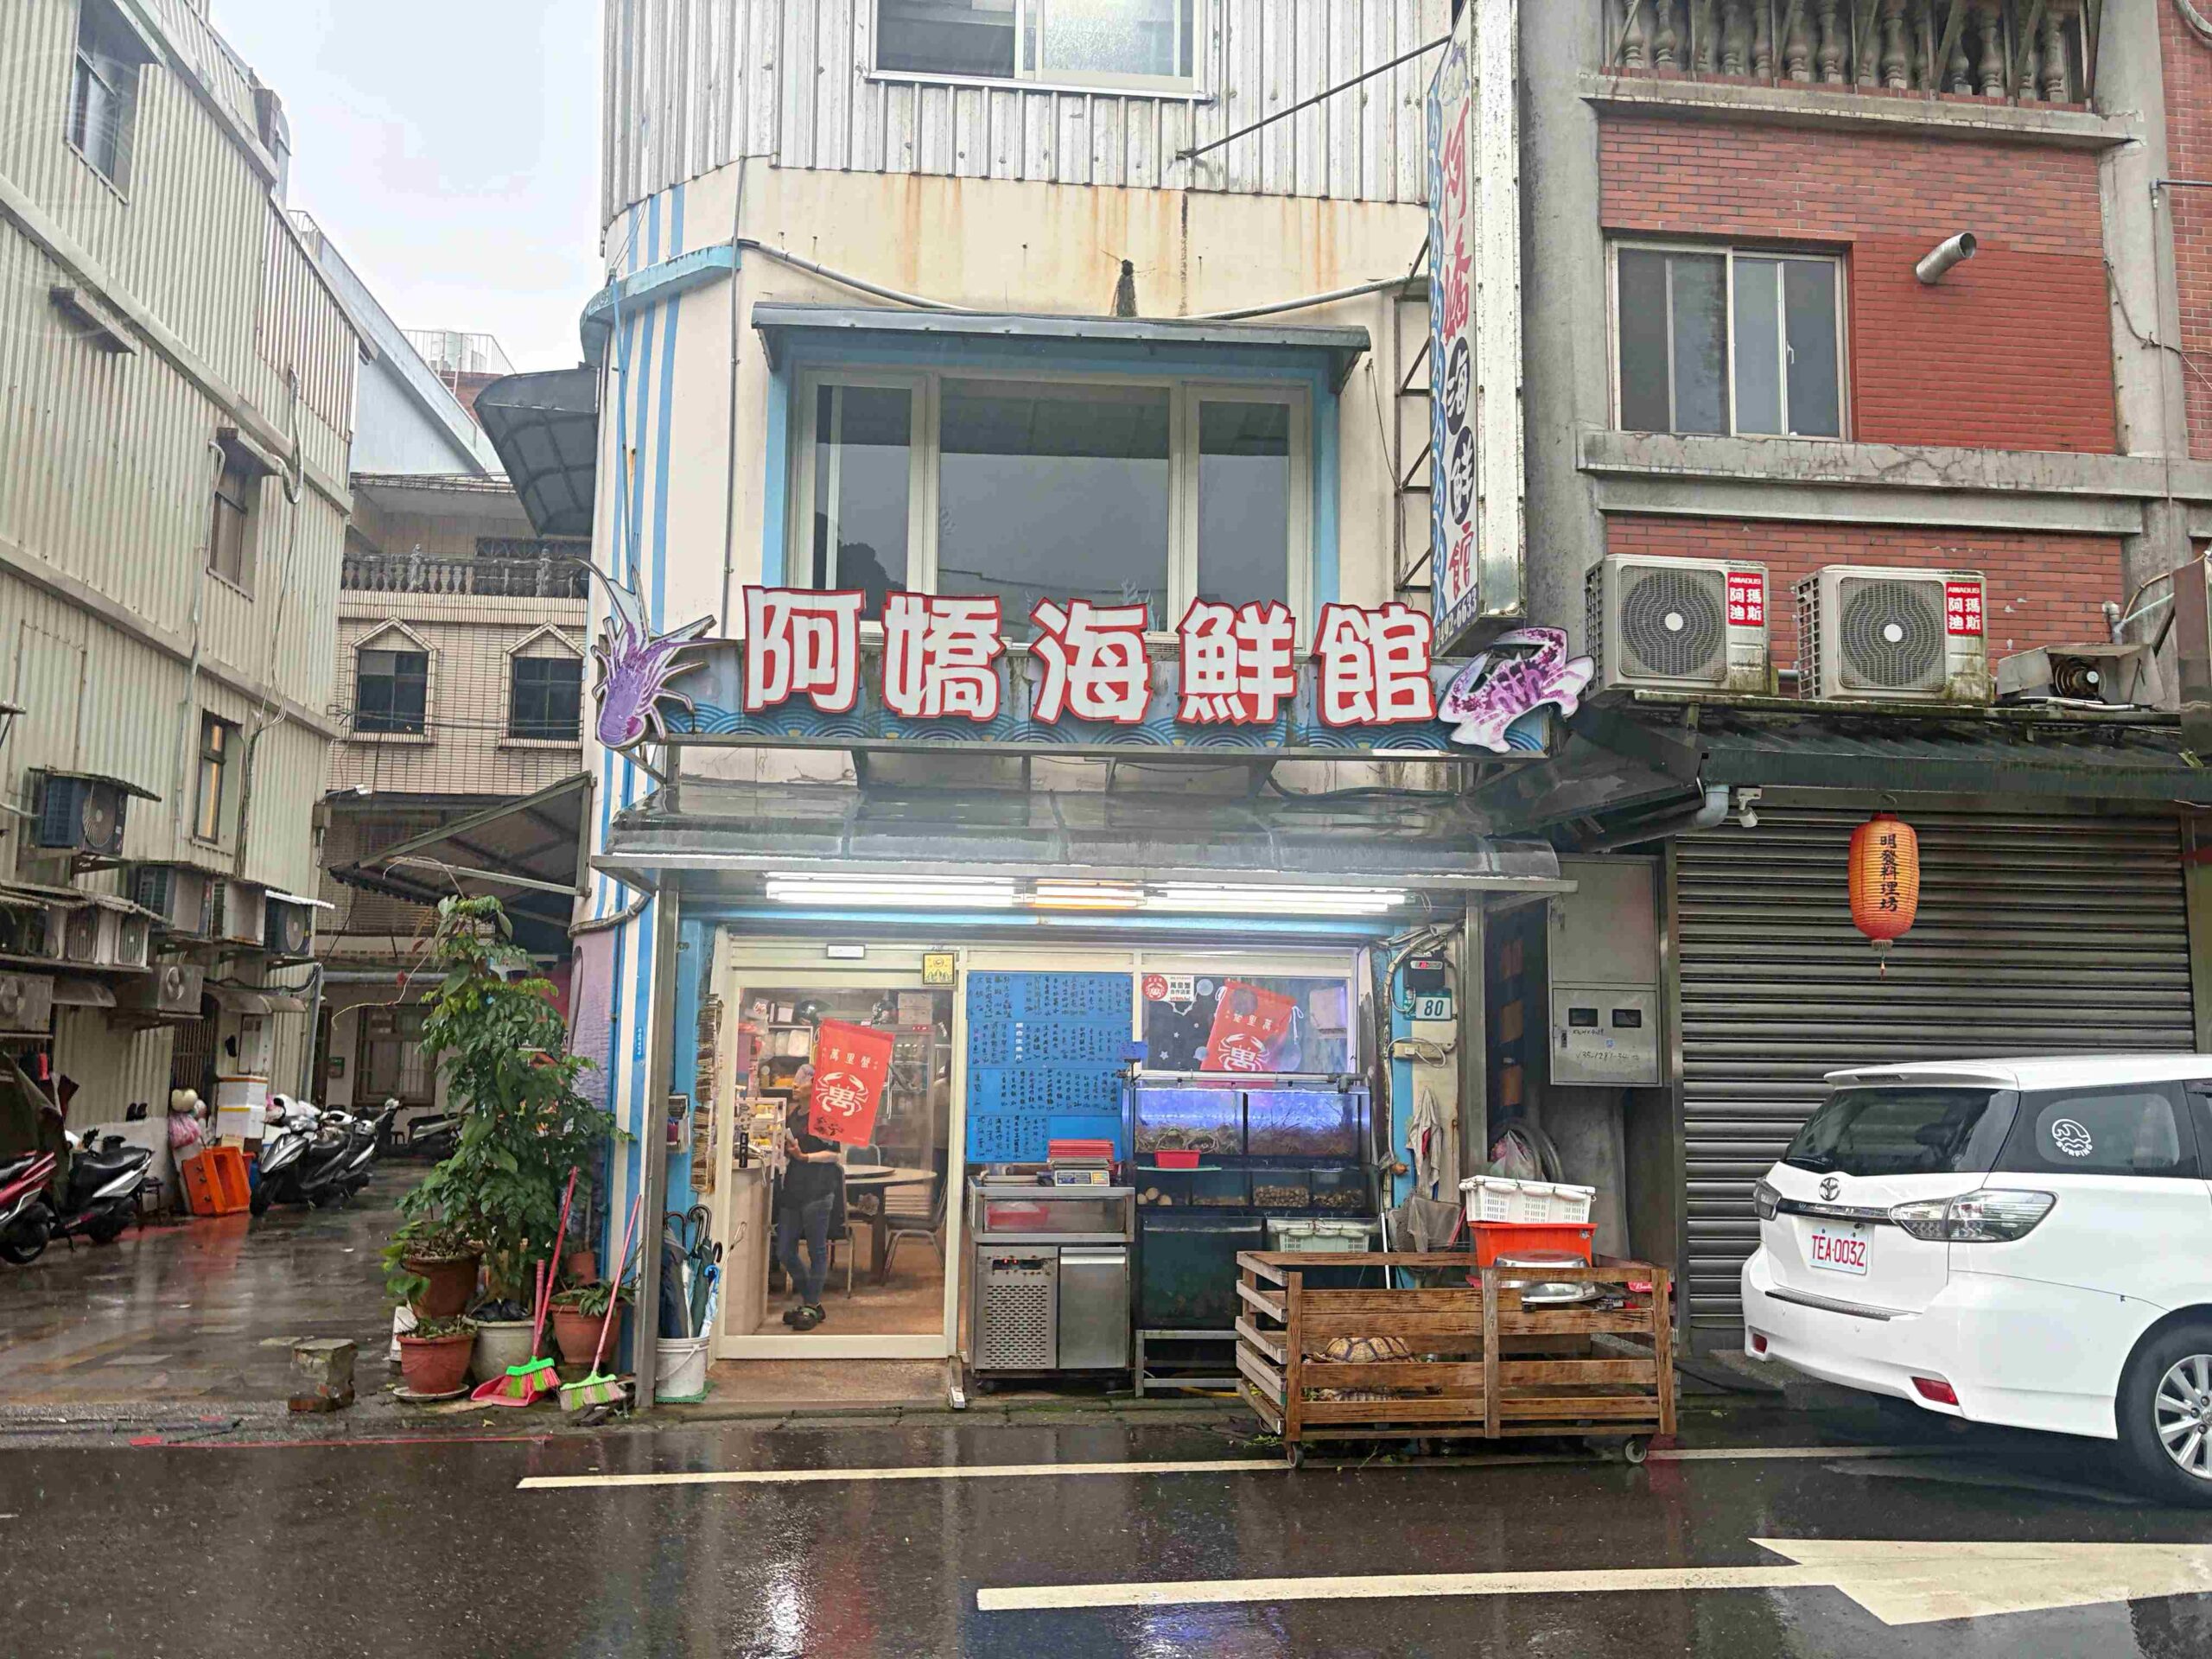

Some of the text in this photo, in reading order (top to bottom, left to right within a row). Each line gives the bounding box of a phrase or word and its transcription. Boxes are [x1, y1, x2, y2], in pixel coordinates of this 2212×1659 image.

[743, 585, 1437, 726] 阿嬌海鮮館
[1879, 833, 1900, 912] 明發料理坊
[1424, 1000, 1444, 1016] 80
[830, 1048, 871, 1069] 萬里蟹
[2055, 1141, 2093, 1158] SURFING
[1811, 1235, 1866, 1268] TEA-0032
